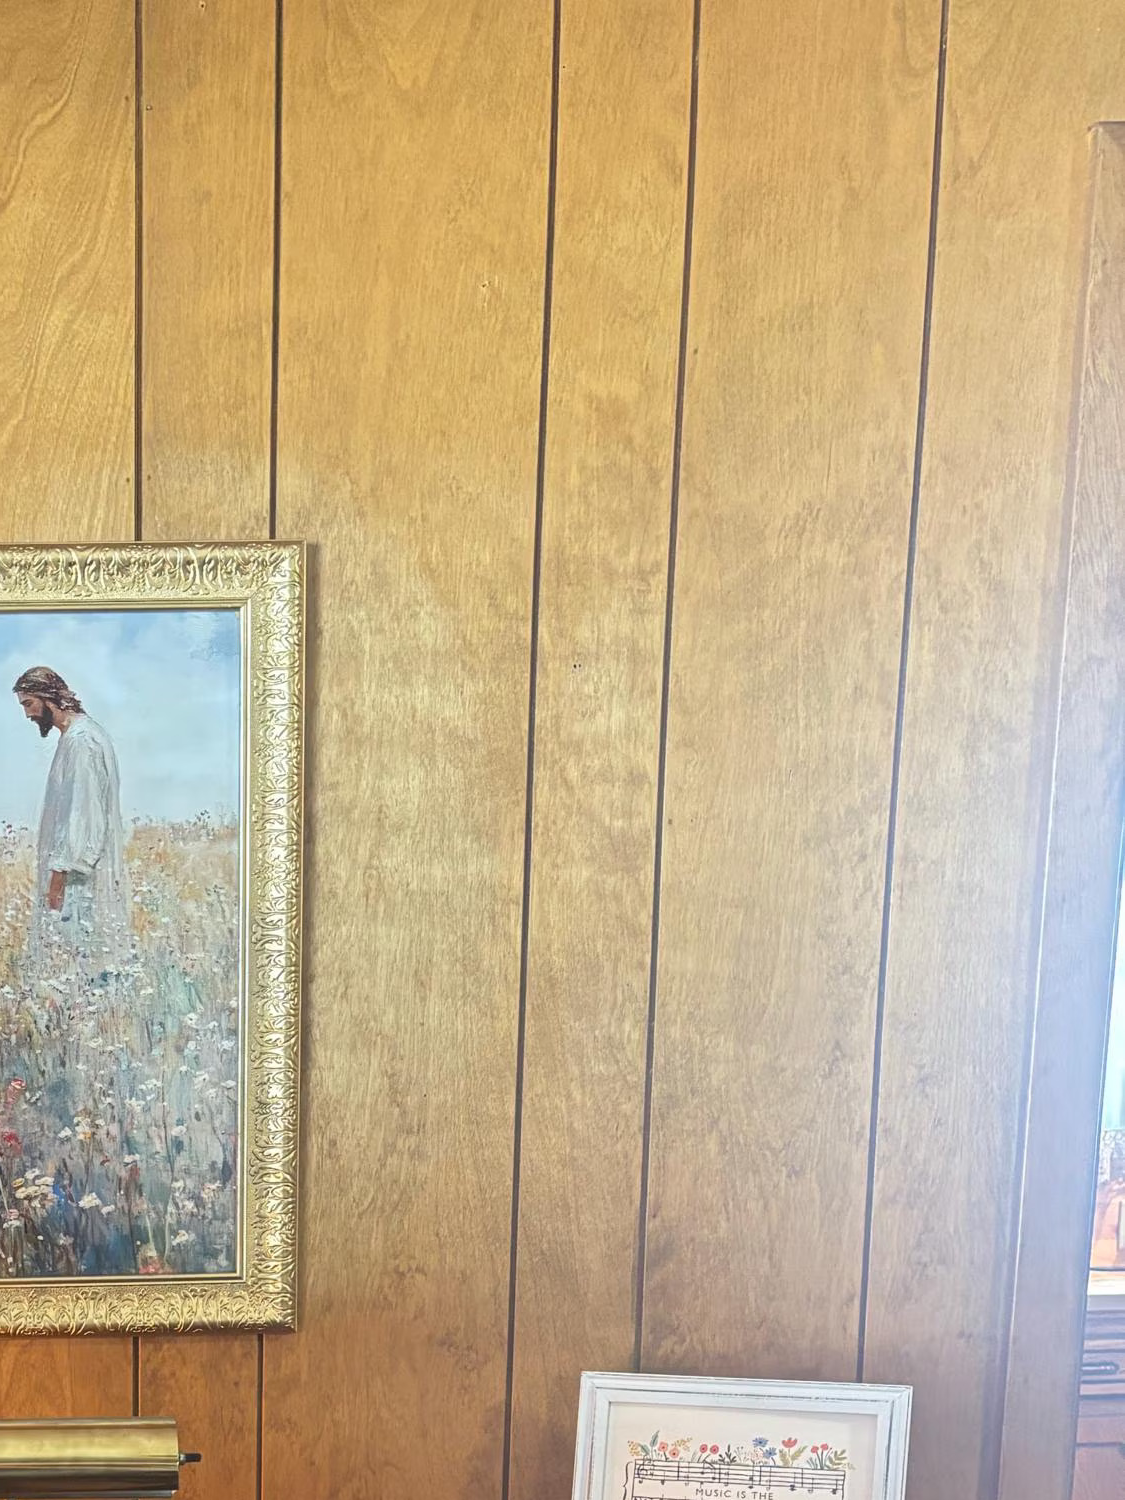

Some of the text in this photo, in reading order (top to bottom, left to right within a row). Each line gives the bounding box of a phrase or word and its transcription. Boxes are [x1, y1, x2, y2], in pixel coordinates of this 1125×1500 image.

[695, 1488, 774, 1500] MUSIC IS THE
